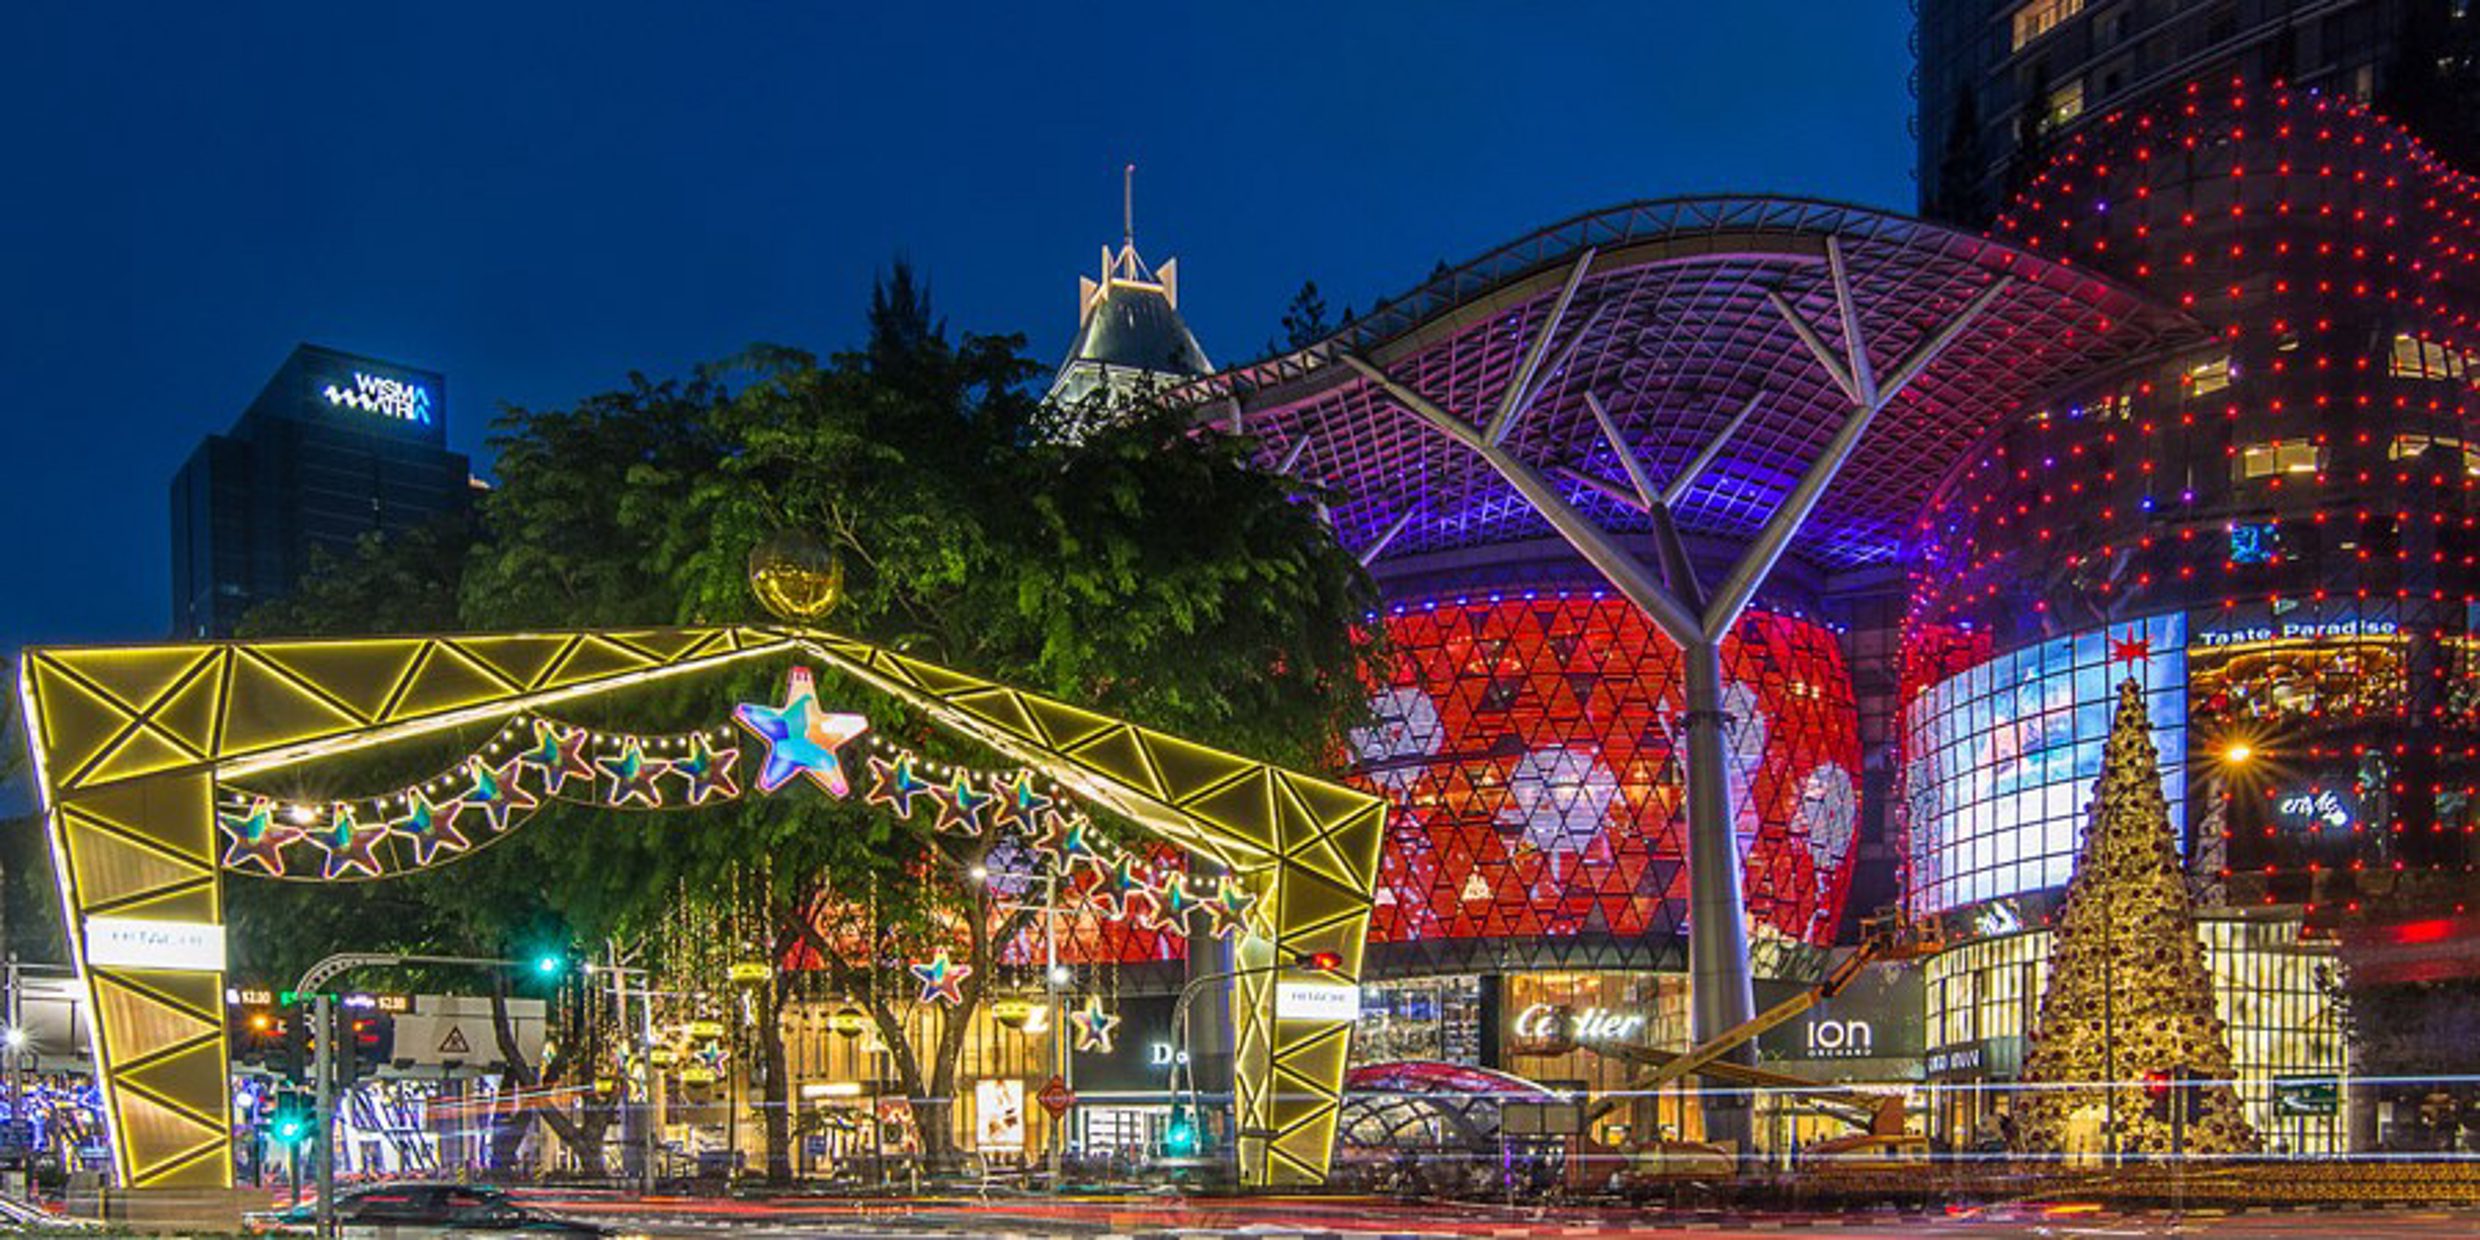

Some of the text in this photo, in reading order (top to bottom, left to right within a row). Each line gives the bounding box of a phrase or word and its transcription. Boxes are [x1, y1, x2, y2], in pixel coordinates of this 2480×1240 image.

[2201, 619, 2396, 645] Taste Paradise
[1514, 1003, 1644, 1038] Catier
